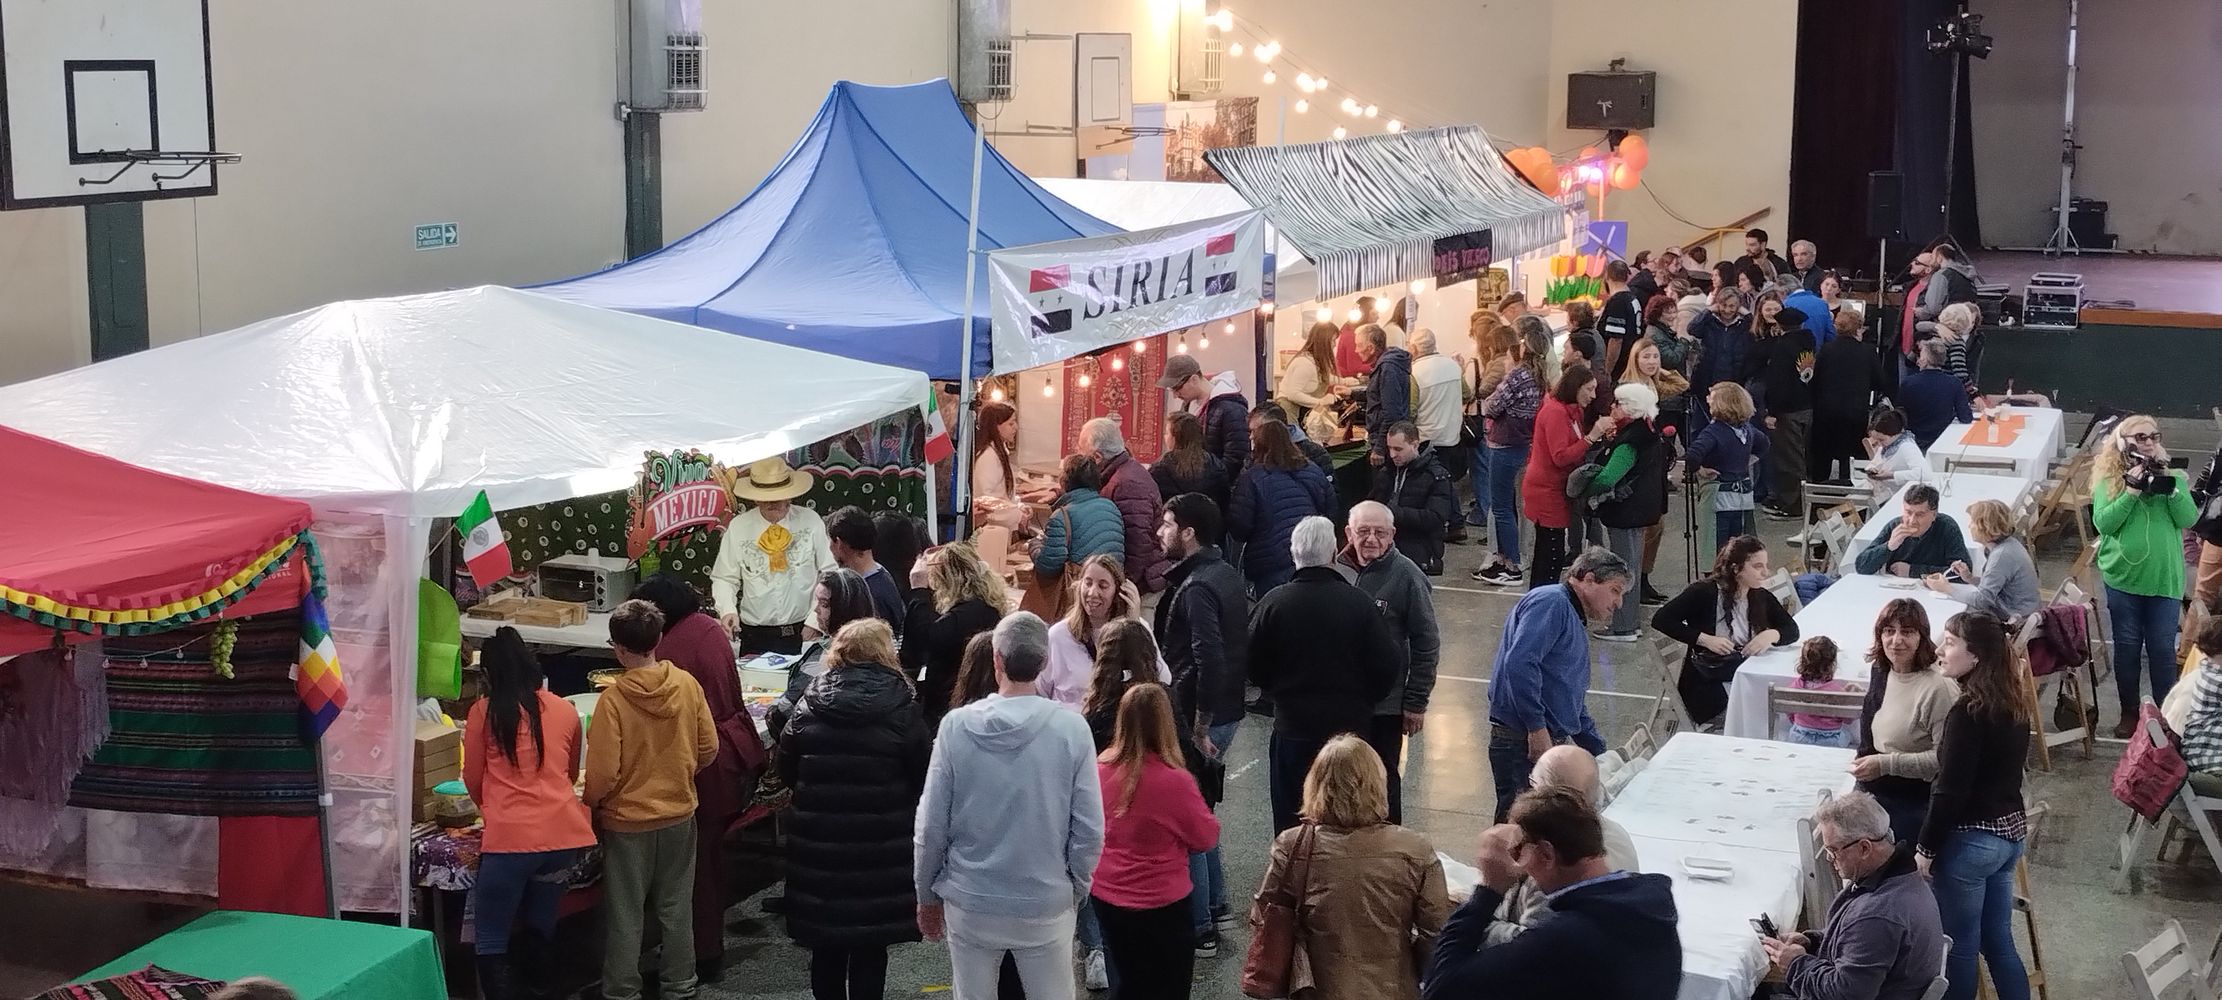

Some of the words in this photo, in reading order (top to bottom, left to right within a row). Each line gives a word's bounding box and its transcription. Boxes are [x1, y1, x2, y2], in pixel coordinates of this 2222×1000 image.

[418, 227, 441, 240] SALIDA
[1082, 248, 1195, 321] SIRIA
[653, 489, 718, 534] MEXICO
